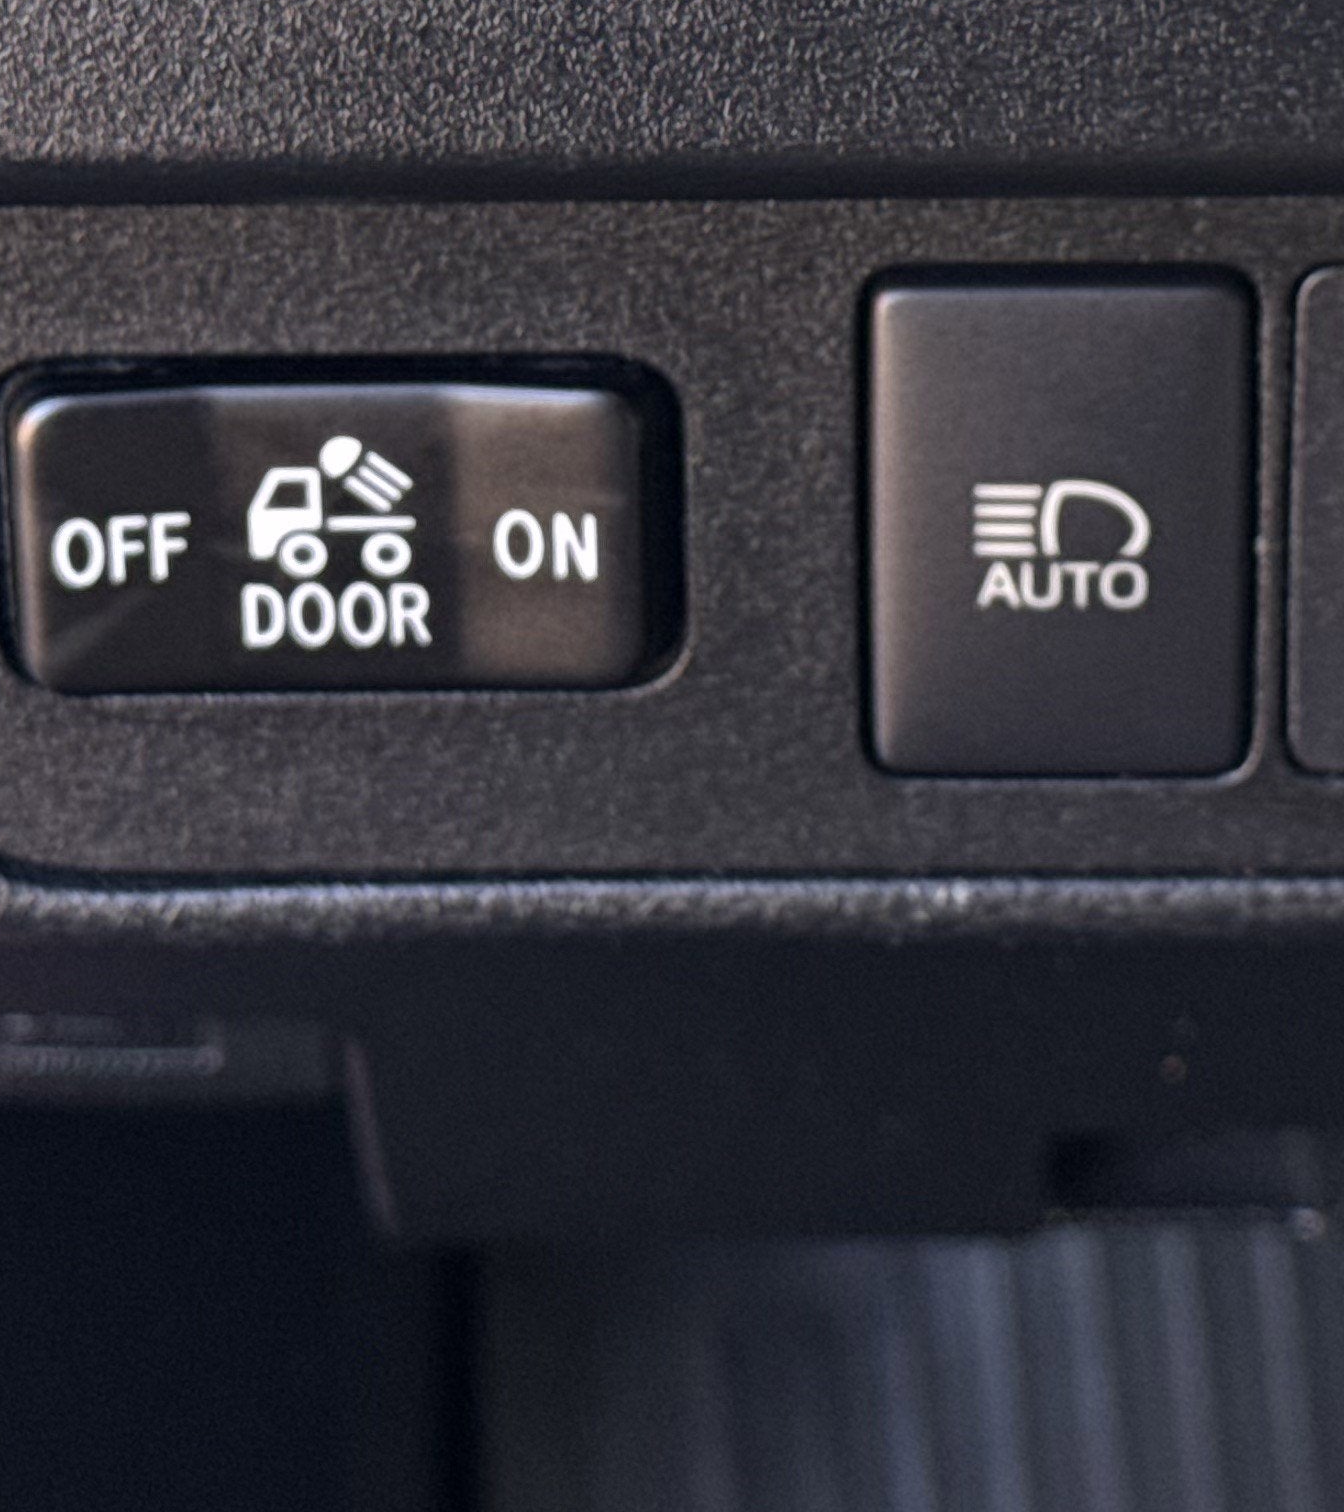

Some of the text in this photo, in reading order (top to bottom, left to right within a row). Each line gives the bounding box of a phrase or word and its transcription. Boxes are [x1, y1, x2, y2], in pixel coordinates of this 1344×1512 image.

[51, 511, 192, 589] OFF
[493, 508, 599, 582] ON
[241, 581, 432, 649] DOOR
[976, 560, 1149, 611] AUTO
